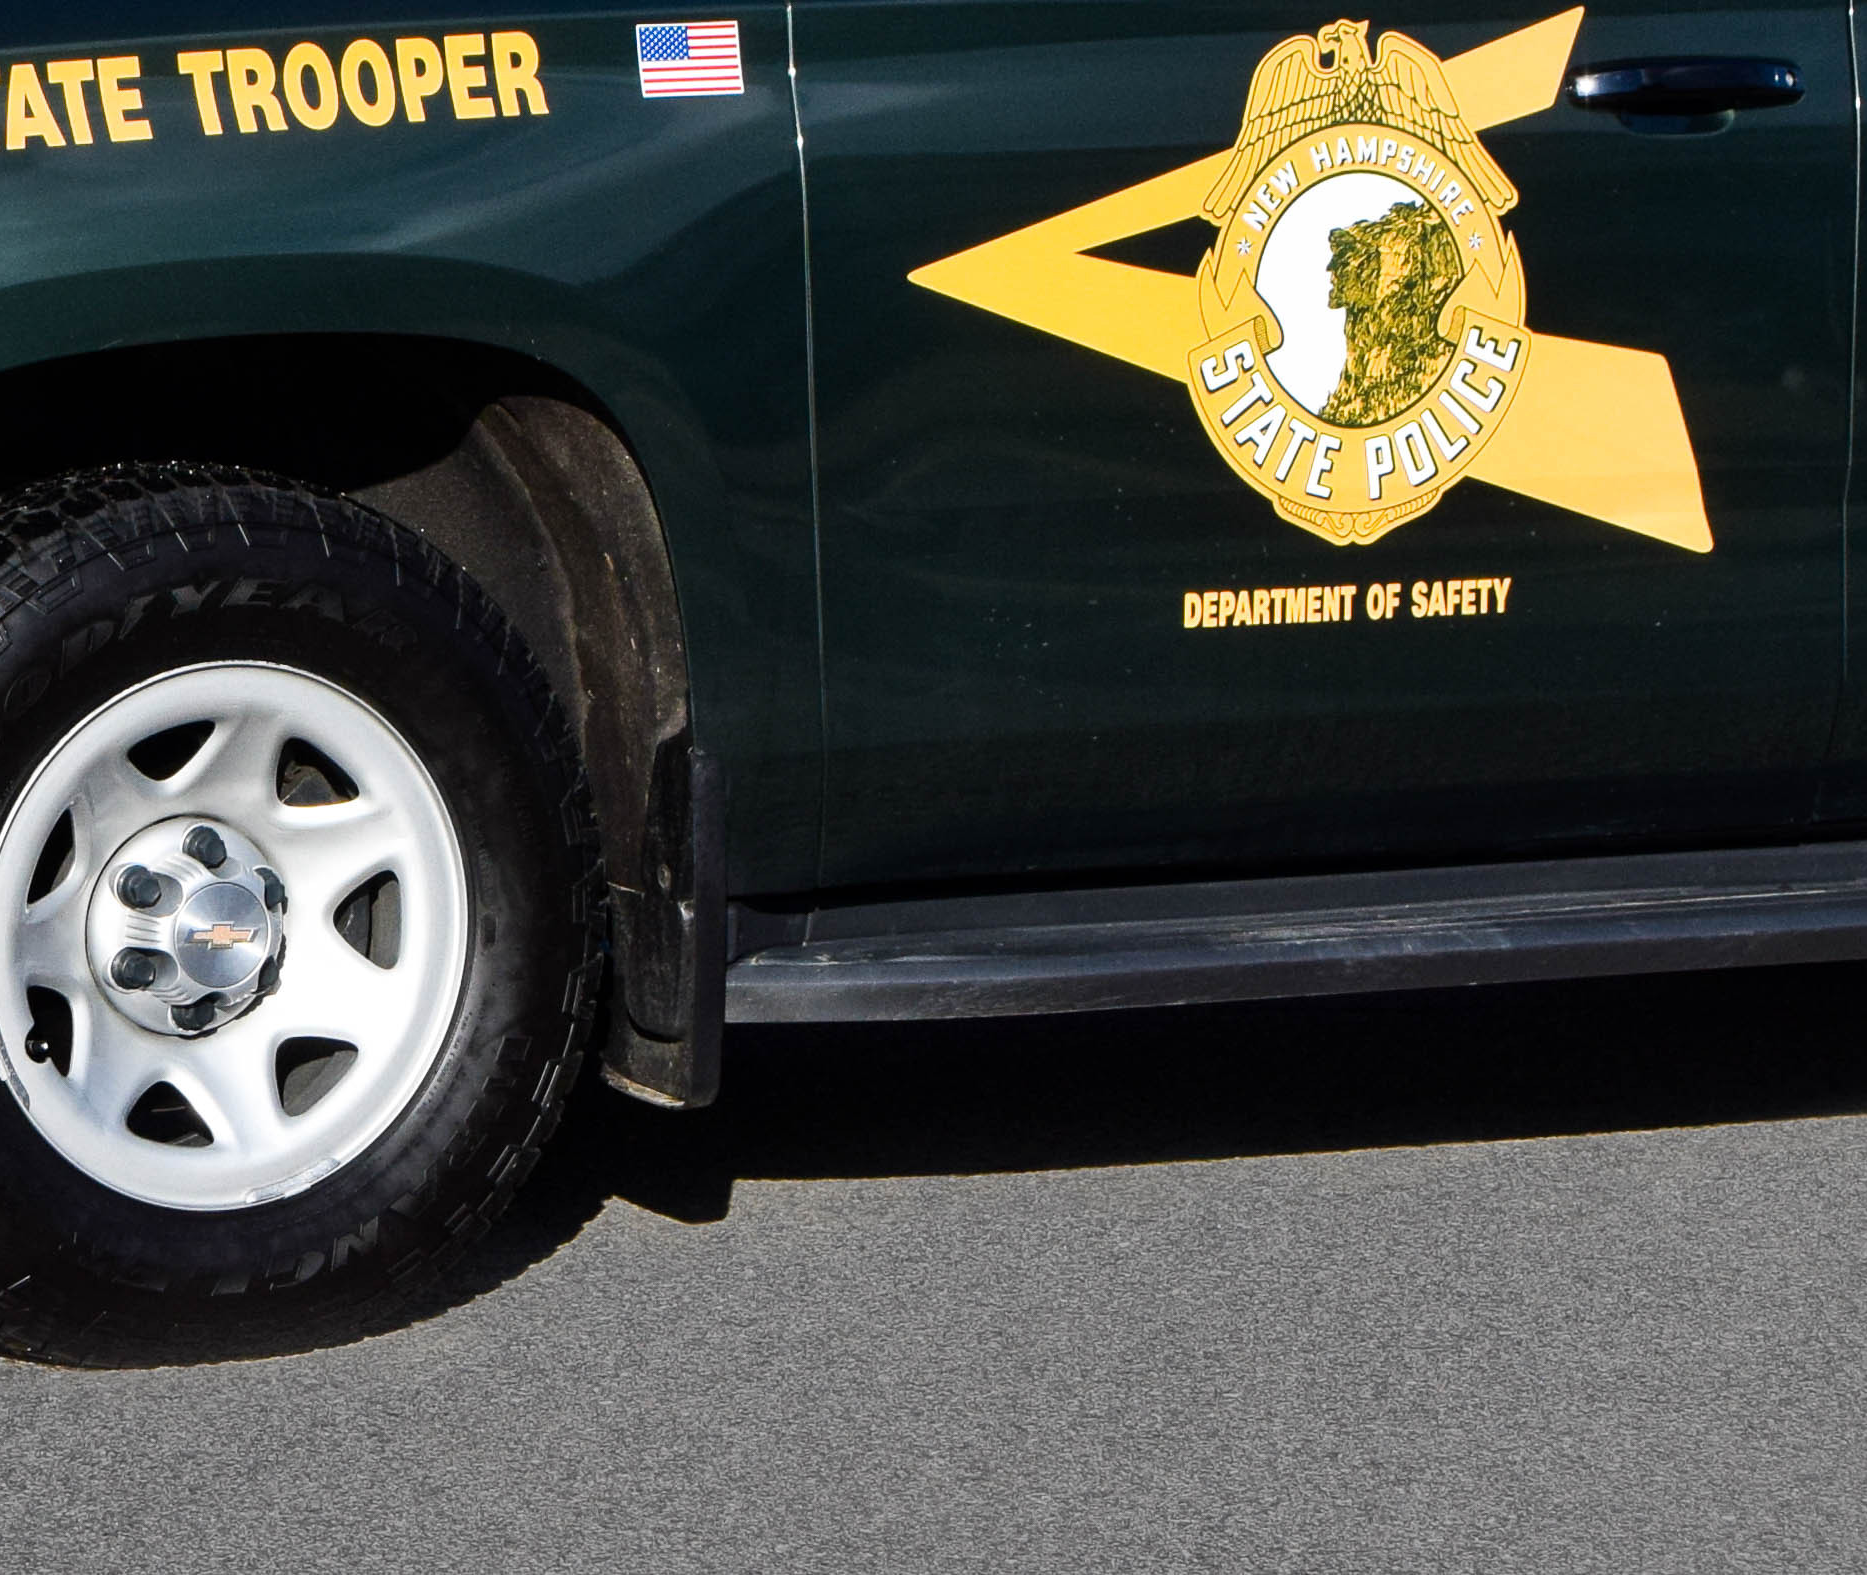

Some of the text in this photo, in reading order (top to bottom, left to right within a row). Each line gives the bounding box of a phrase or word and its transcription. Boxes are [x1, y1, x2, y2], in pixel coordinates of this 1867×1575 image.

[177, 31, 549, 135] TROOPER
[1242, 135, 1474, 232] NEW HAMPSHIRE
[1201, 326, 1521, 500] STATE POLICE
[1184, 577, 1511, 628] DEPARTMENT OF SAFETY
